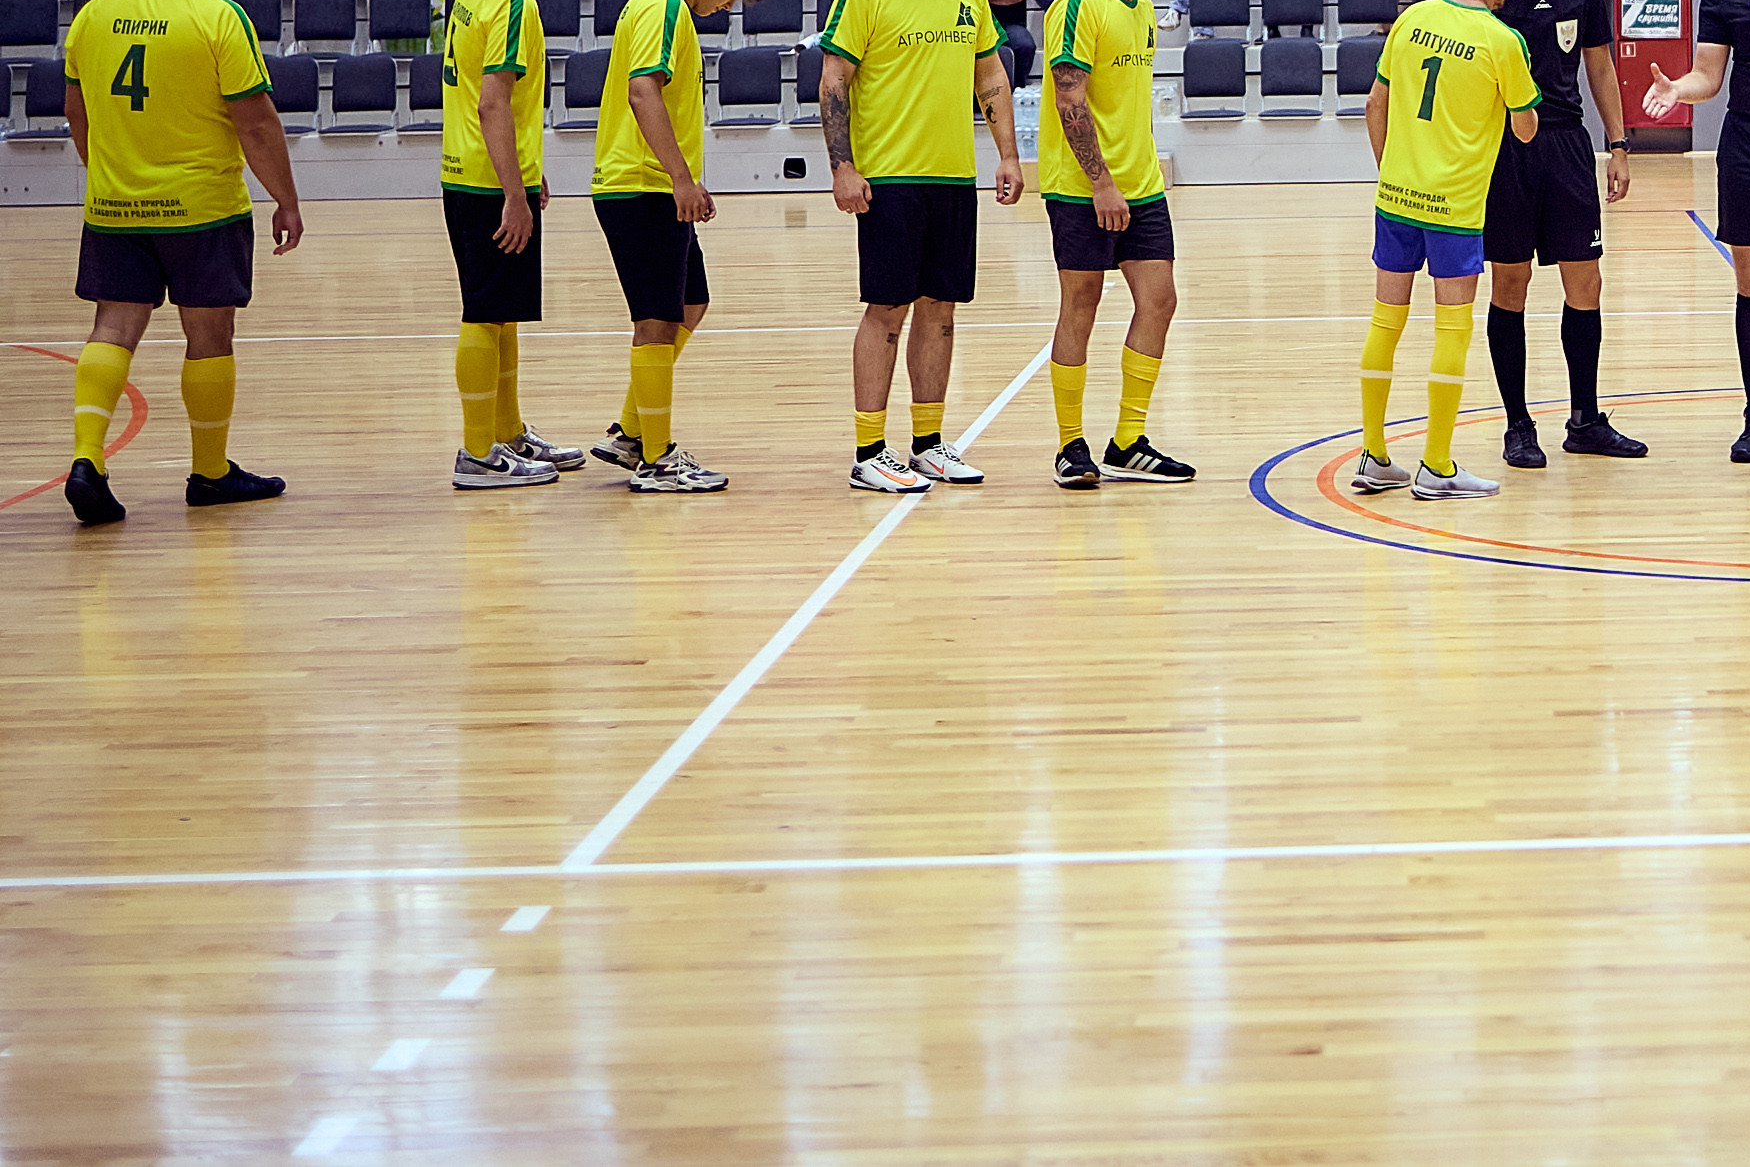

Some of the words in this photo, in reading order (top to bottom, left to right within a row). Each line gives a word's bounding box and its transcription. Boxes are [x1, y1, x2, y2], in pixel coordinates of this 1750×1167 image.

[1645, 4, 1679, 15] ВРЕМЯ
[112, 18, 169, 35] СПИРИН
[1409, 28, 1476, 61] ЯЛТУНОВ
[110, 44, 150, 112] 4
[1416, 55, 1444, 122] 1
[98, 198, 133, 207] ГАРМОНИИ
[140, 197, 183, 208] ПРИРОДОЙ,
[1410, 189, 1448, 205] ПРИРОДОЙ,
[130, 209, 161, 219] РОДНОЙ
[161, 209, 193, 218] ЗЕМЛЕ!
[1400, 198, 1425, 210] РОДНОЙ
[1426, 204, 1452, 215] ЗЕМЛЕ!
